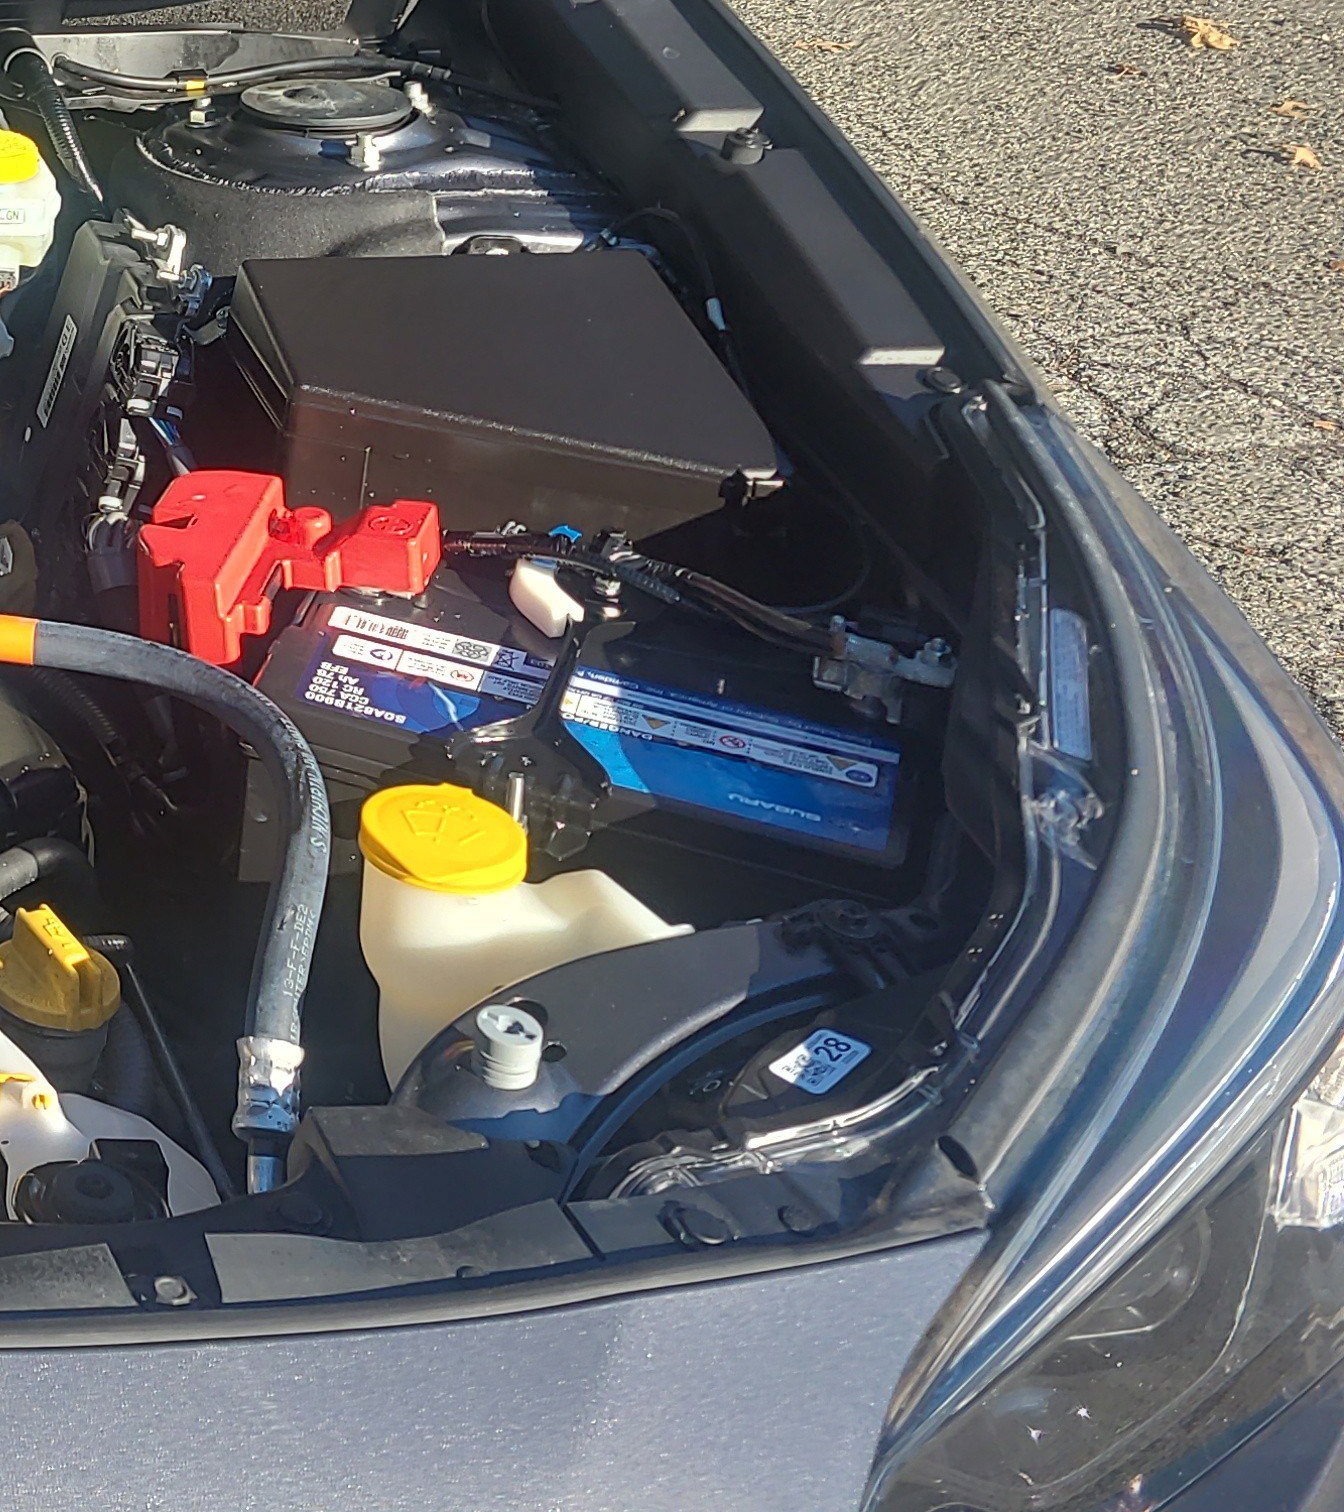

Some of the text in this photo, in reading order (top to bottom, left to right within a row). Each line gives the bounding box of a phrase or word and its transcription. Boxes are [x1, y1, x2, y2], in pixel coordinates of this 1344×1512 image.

[312, 675, 339, 689] 120
[339, 691, 370, 705] CCA
[728, 792, 821, 822] SUBARU
[814, 1038, 850, 1061] 28
